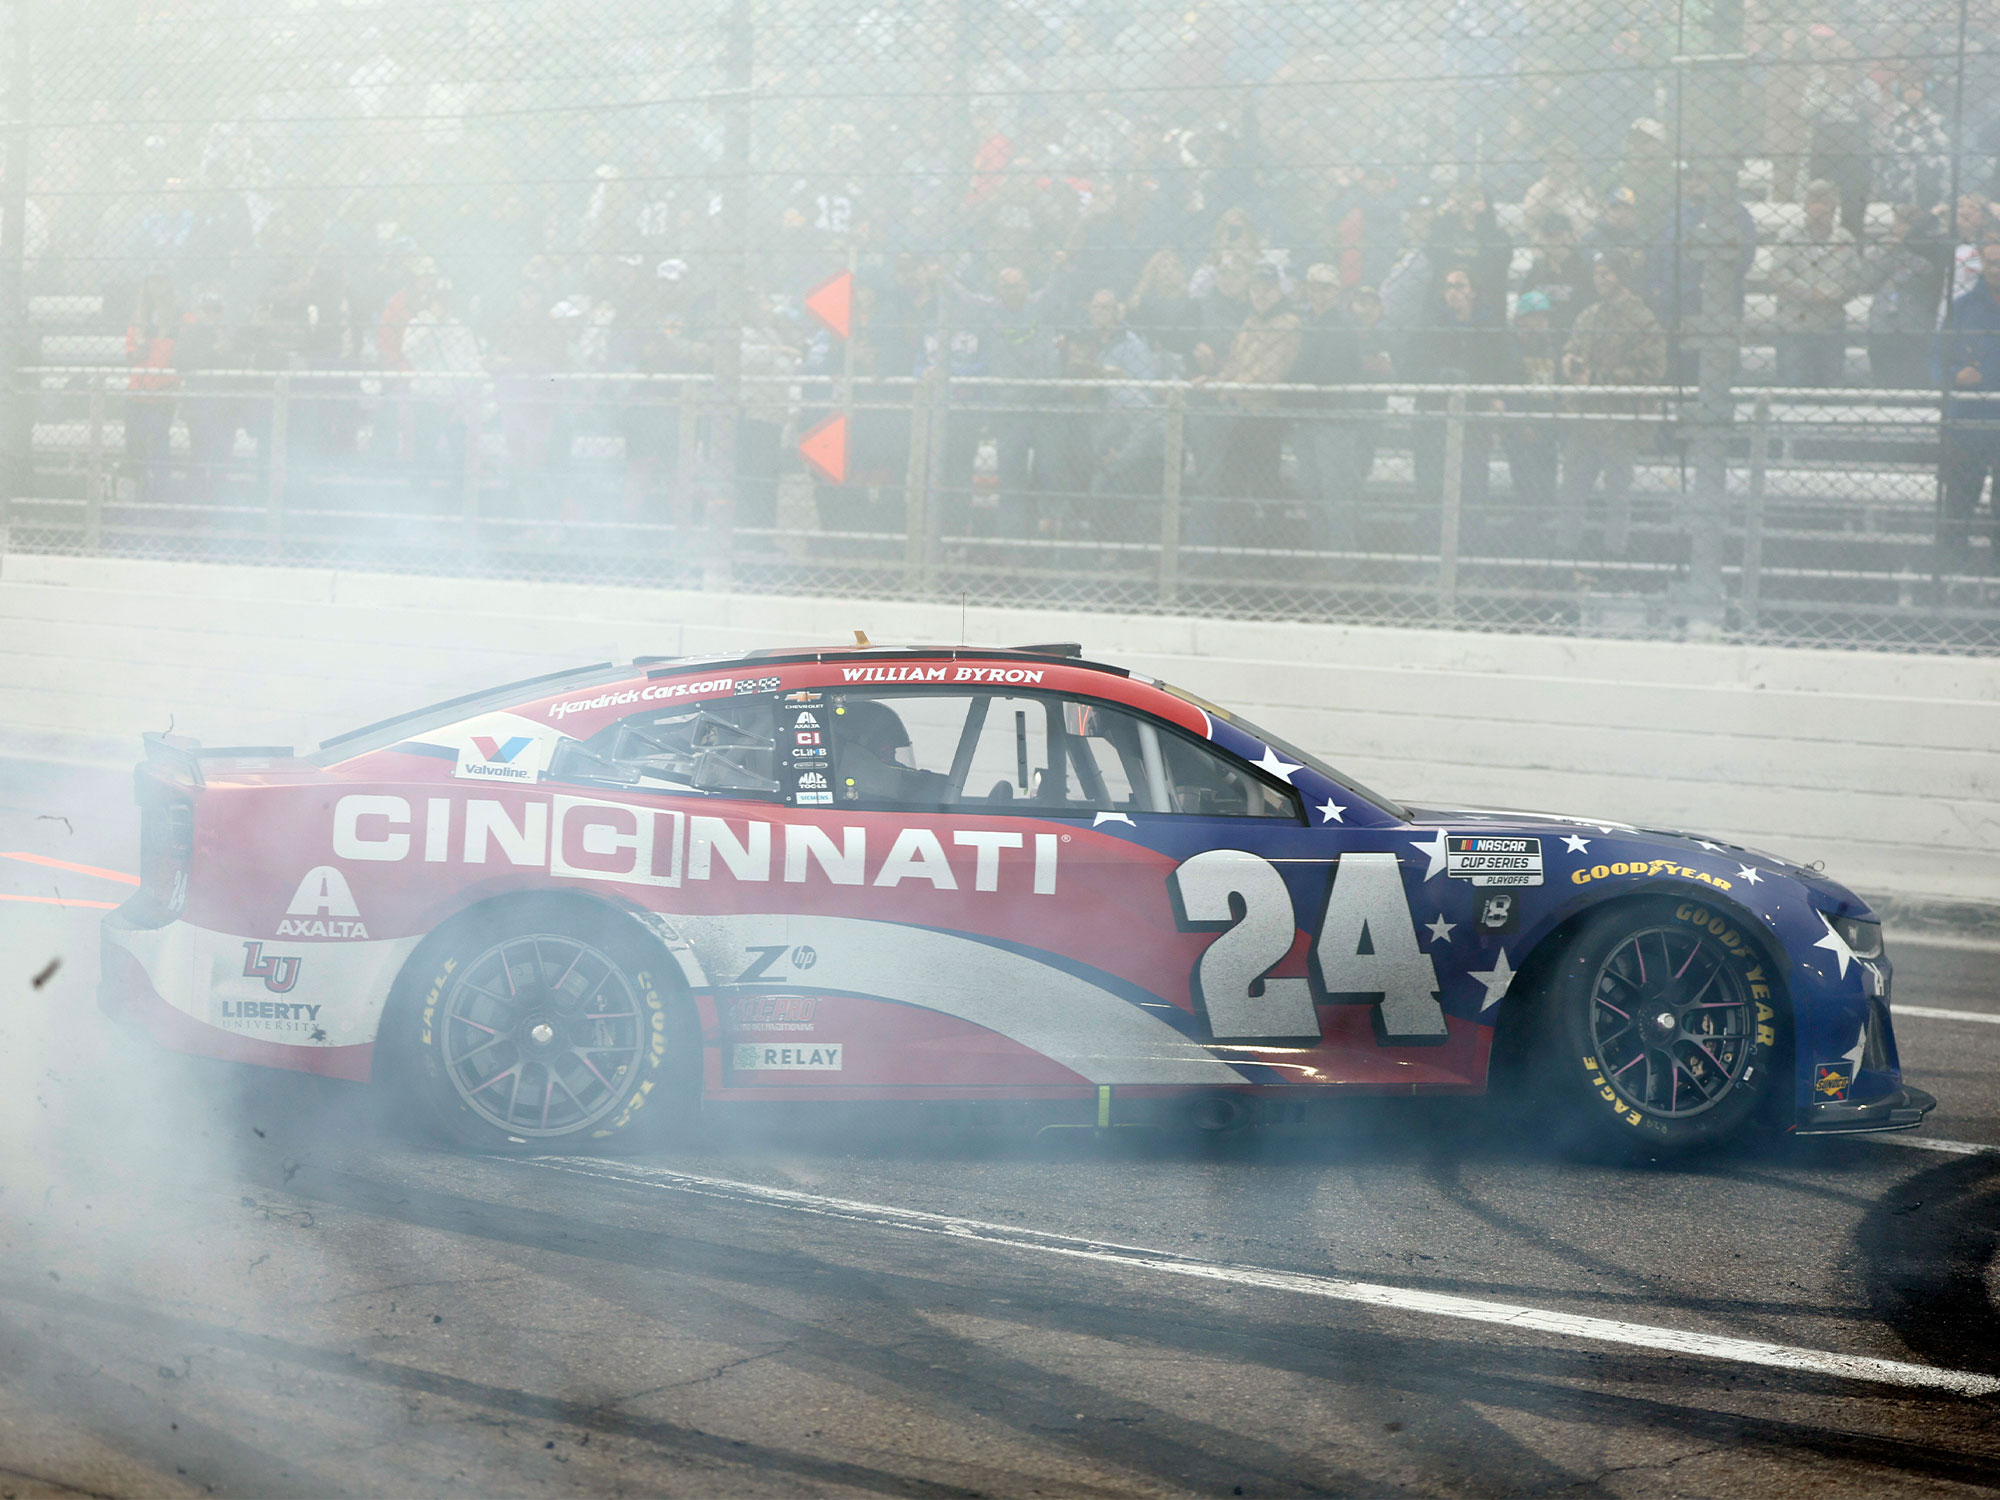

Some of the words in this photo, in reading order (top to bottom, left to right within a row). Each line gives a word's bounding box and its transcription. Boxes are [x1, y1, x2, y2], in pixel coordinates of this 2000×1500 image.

[842, 667, 948, 681] WILLIAM
[953, 668, 1045, 683] BYRON
[465, 763, 528, 778] Valvoline
[332, 794, 1060, 895] CINCINNATI
[1476, 840, 1527, 852] NASCAR
[1461, 857, 1485, 868] CUP
[1486, 857, 1529, 868] SERIES
[1487, 876, 1530, 884] PLAYOFFS
[1570, 859, 1733, 892] GOODYEAR
[1486, 895, 1512, 928] 8
[276, 919, 369, 939] AXALTA
[1168, 849, 1449, 1042] 24
[242, 941, 302, 993] LU
[734, 945, 791, 982] Z
[792, 945, 817, 970] hp
[1675, 903, 1775, 1047] GOODYEAR
[221, 1001, 322, 1022] LIBERTY
[422, 957, 456, 1045] EAGLE
[222, 1020, 321, 1032] UNIVERSITY
[764, 1049, 838, 1065] RELAY
[1582, 1055, 1641, 1127] EAGLE
[1816, 1076, 1849, 1091] SUNOCO
